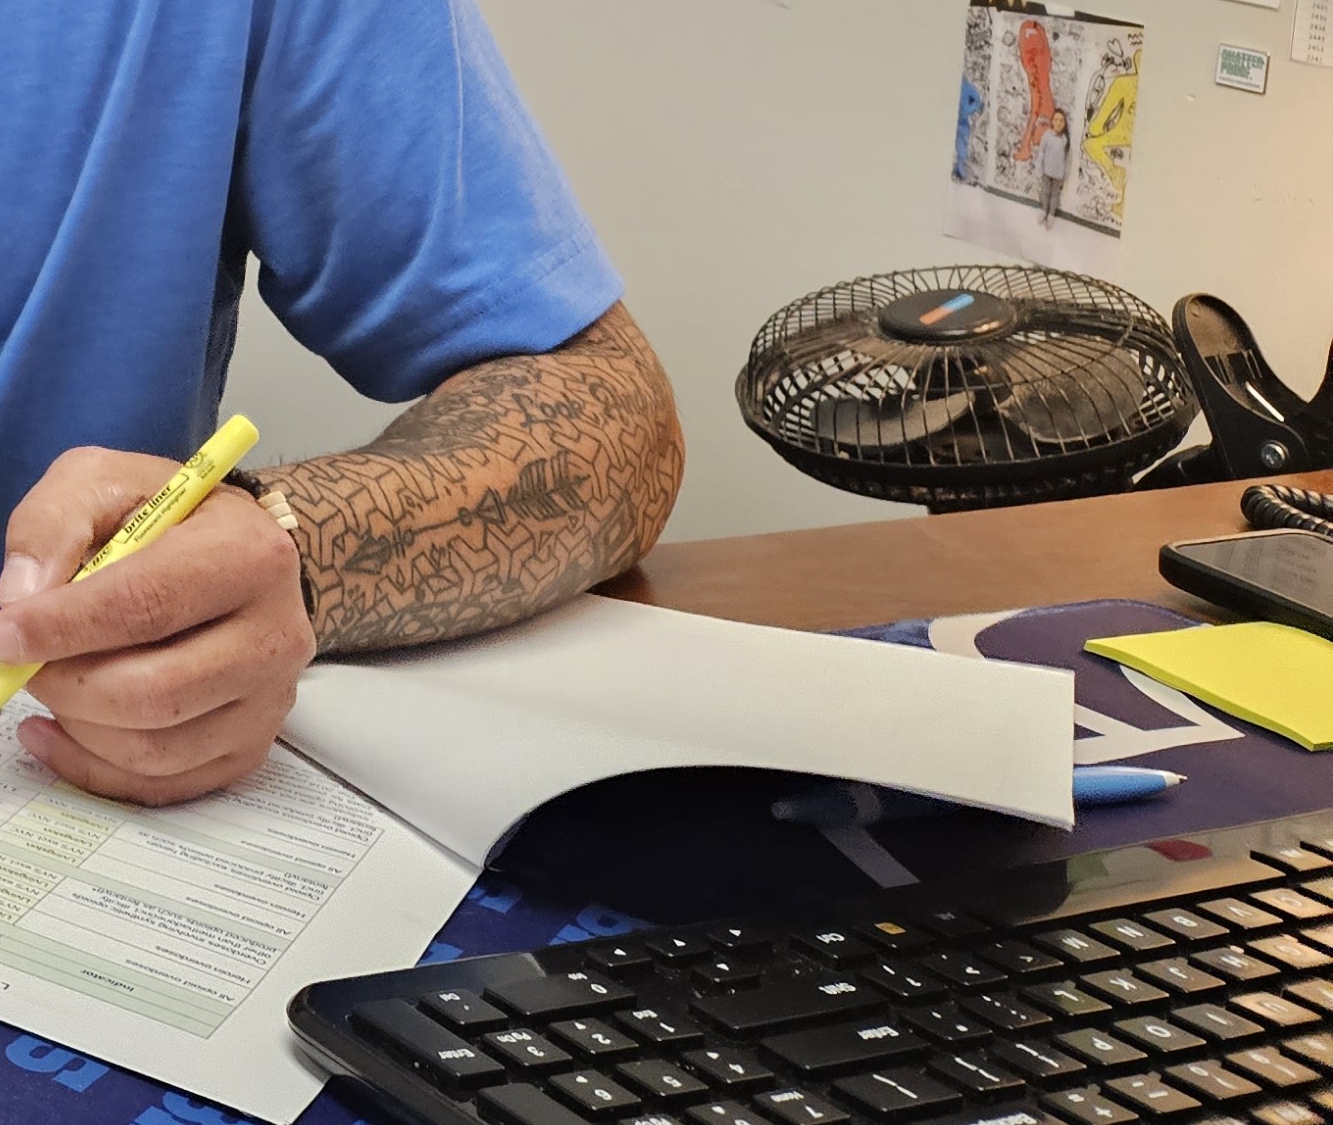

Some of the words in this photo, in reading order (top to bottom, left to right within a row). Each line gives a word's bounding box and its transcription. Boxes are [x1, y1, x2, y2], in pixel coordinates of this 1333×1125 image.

[124, 507, 149, 535] brite
[124, 958, 183, 983] overdoses
[80, 969, 135, 993] Indicator
[181, 980, 219, 996] opioid
[217, 993, 236, 1002] All
[856, 1026, 899, 1042] Enter
[437, 1046, 475, 1062] Enter
